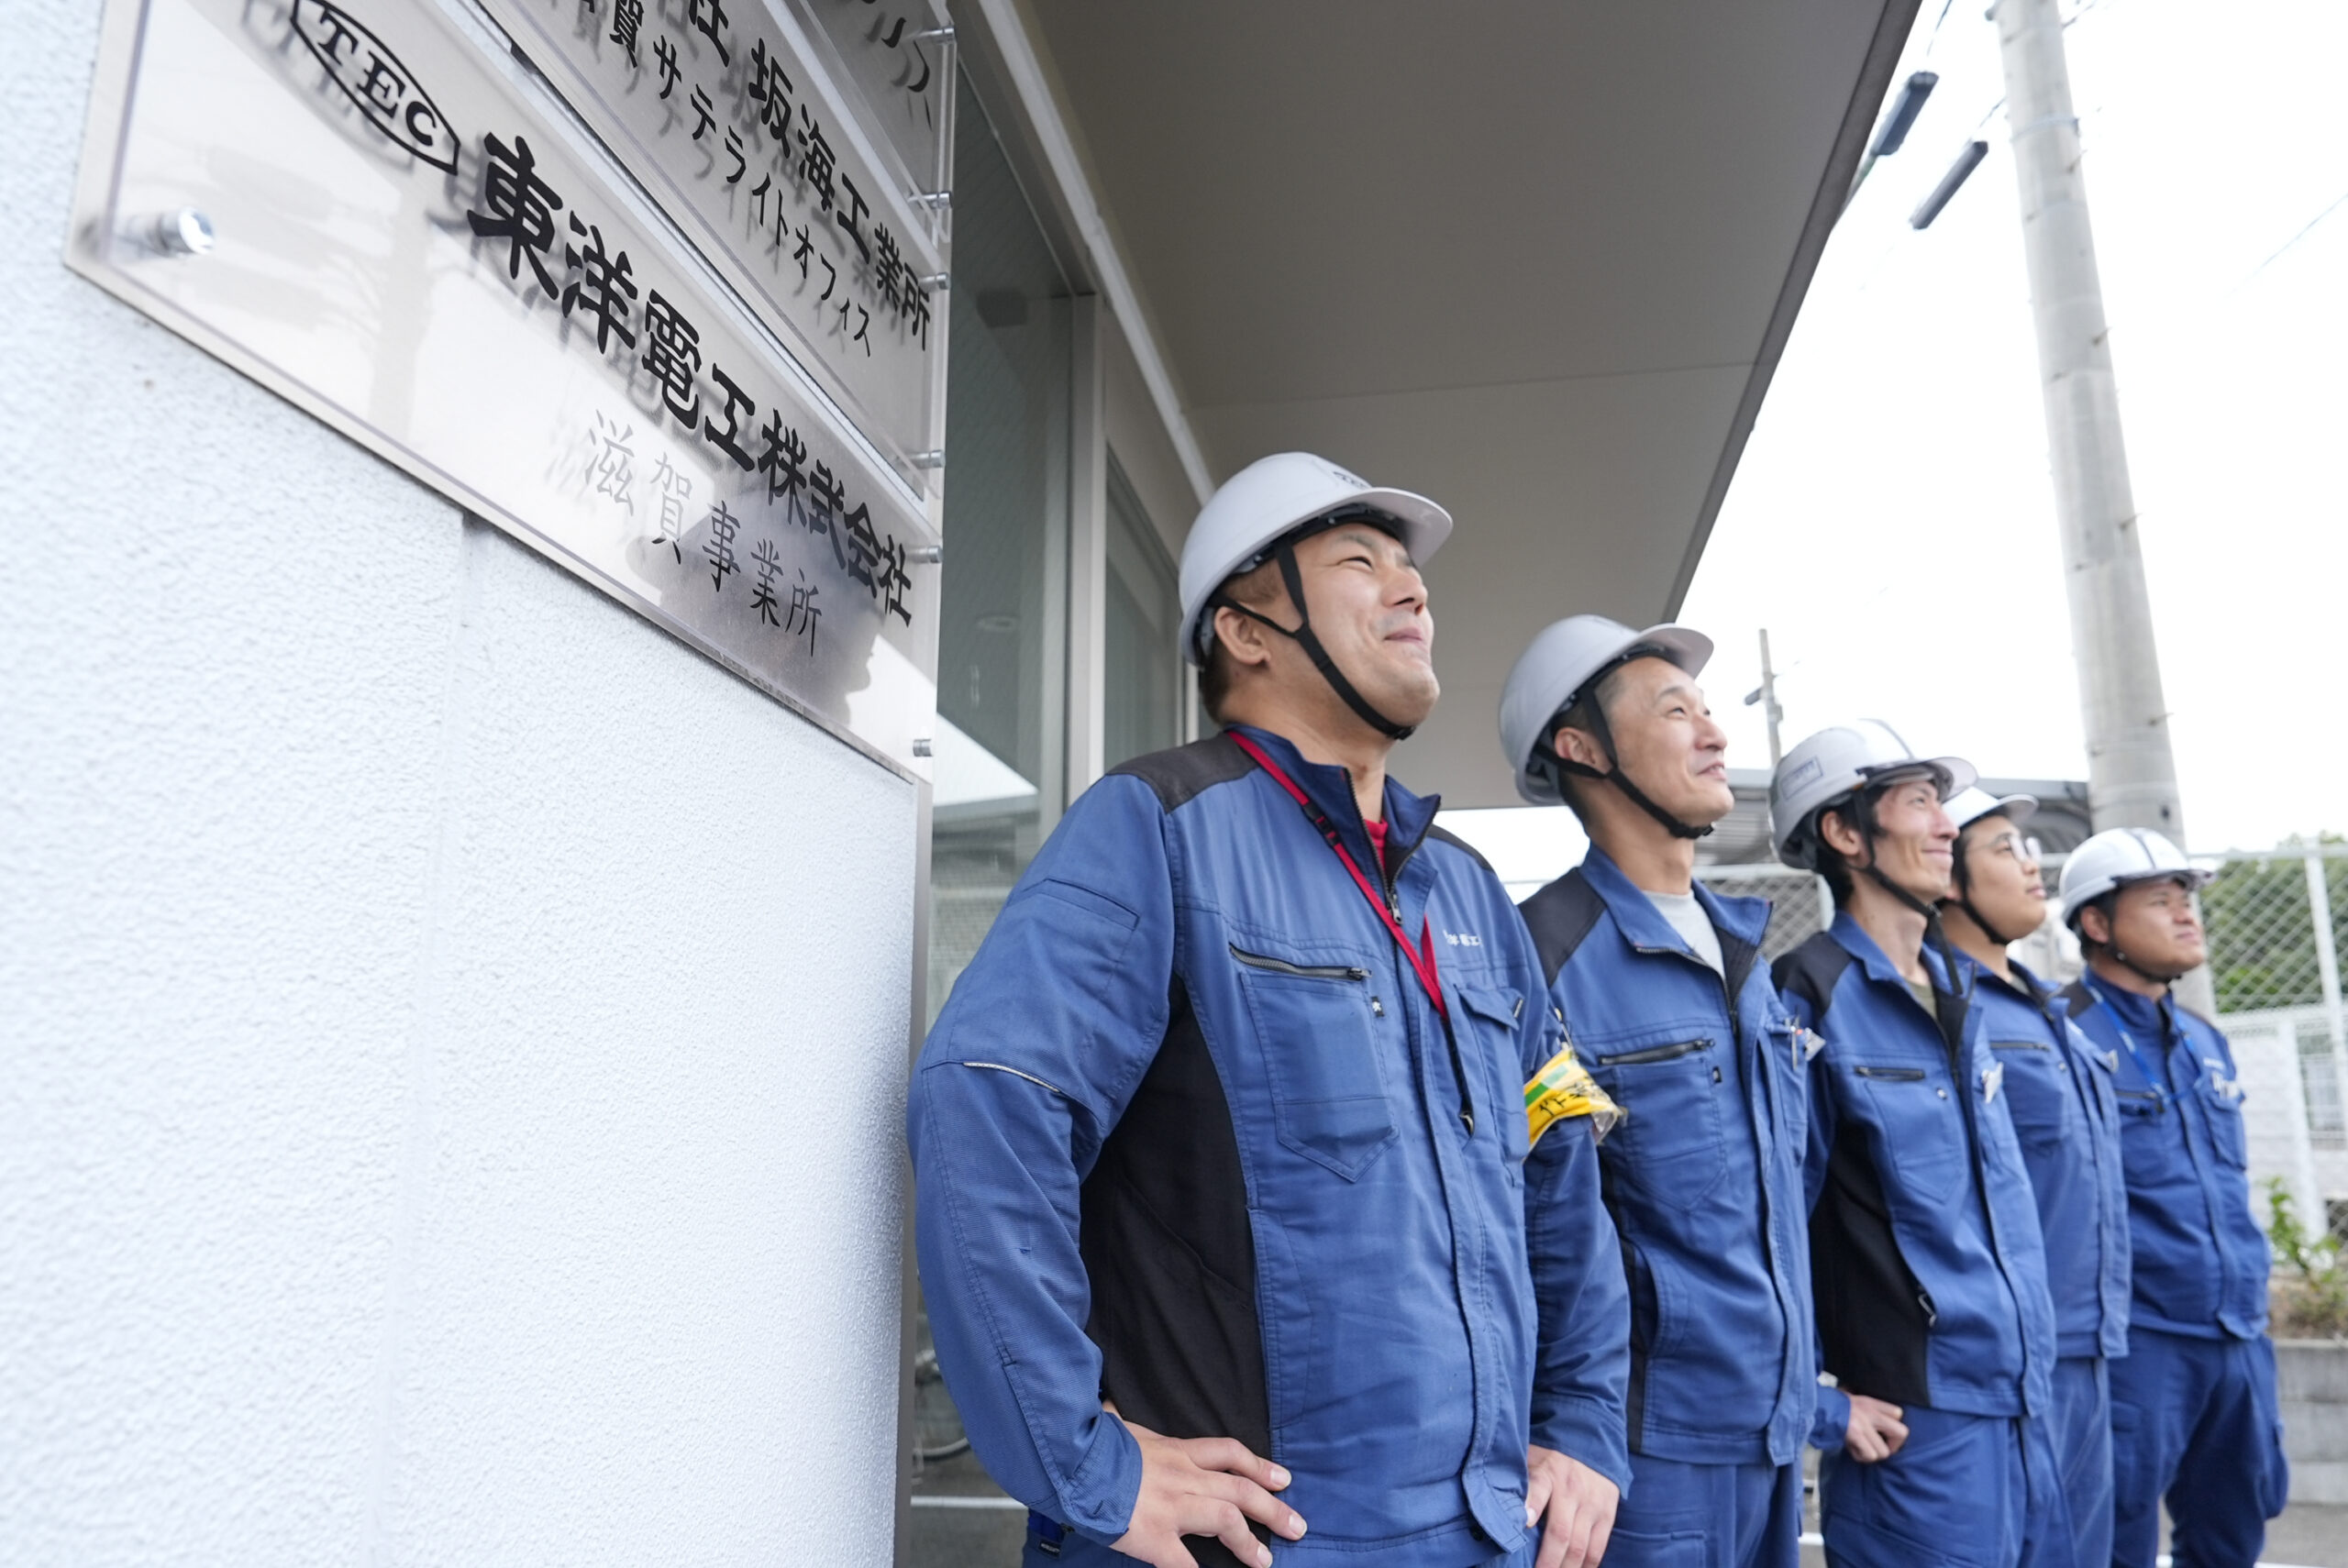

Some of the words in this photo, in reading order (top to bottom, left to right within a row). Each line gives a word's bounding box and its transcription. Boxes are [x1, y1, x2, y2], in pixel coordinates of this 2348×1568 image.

[317, 8, 437, 147] TEC
[589, 0, 870, 358] 賀サテライトオフィス
[467, 131, 913, 627] 東洋電工株式会社
[584, 408, 822, 657] 滋賀事業所
